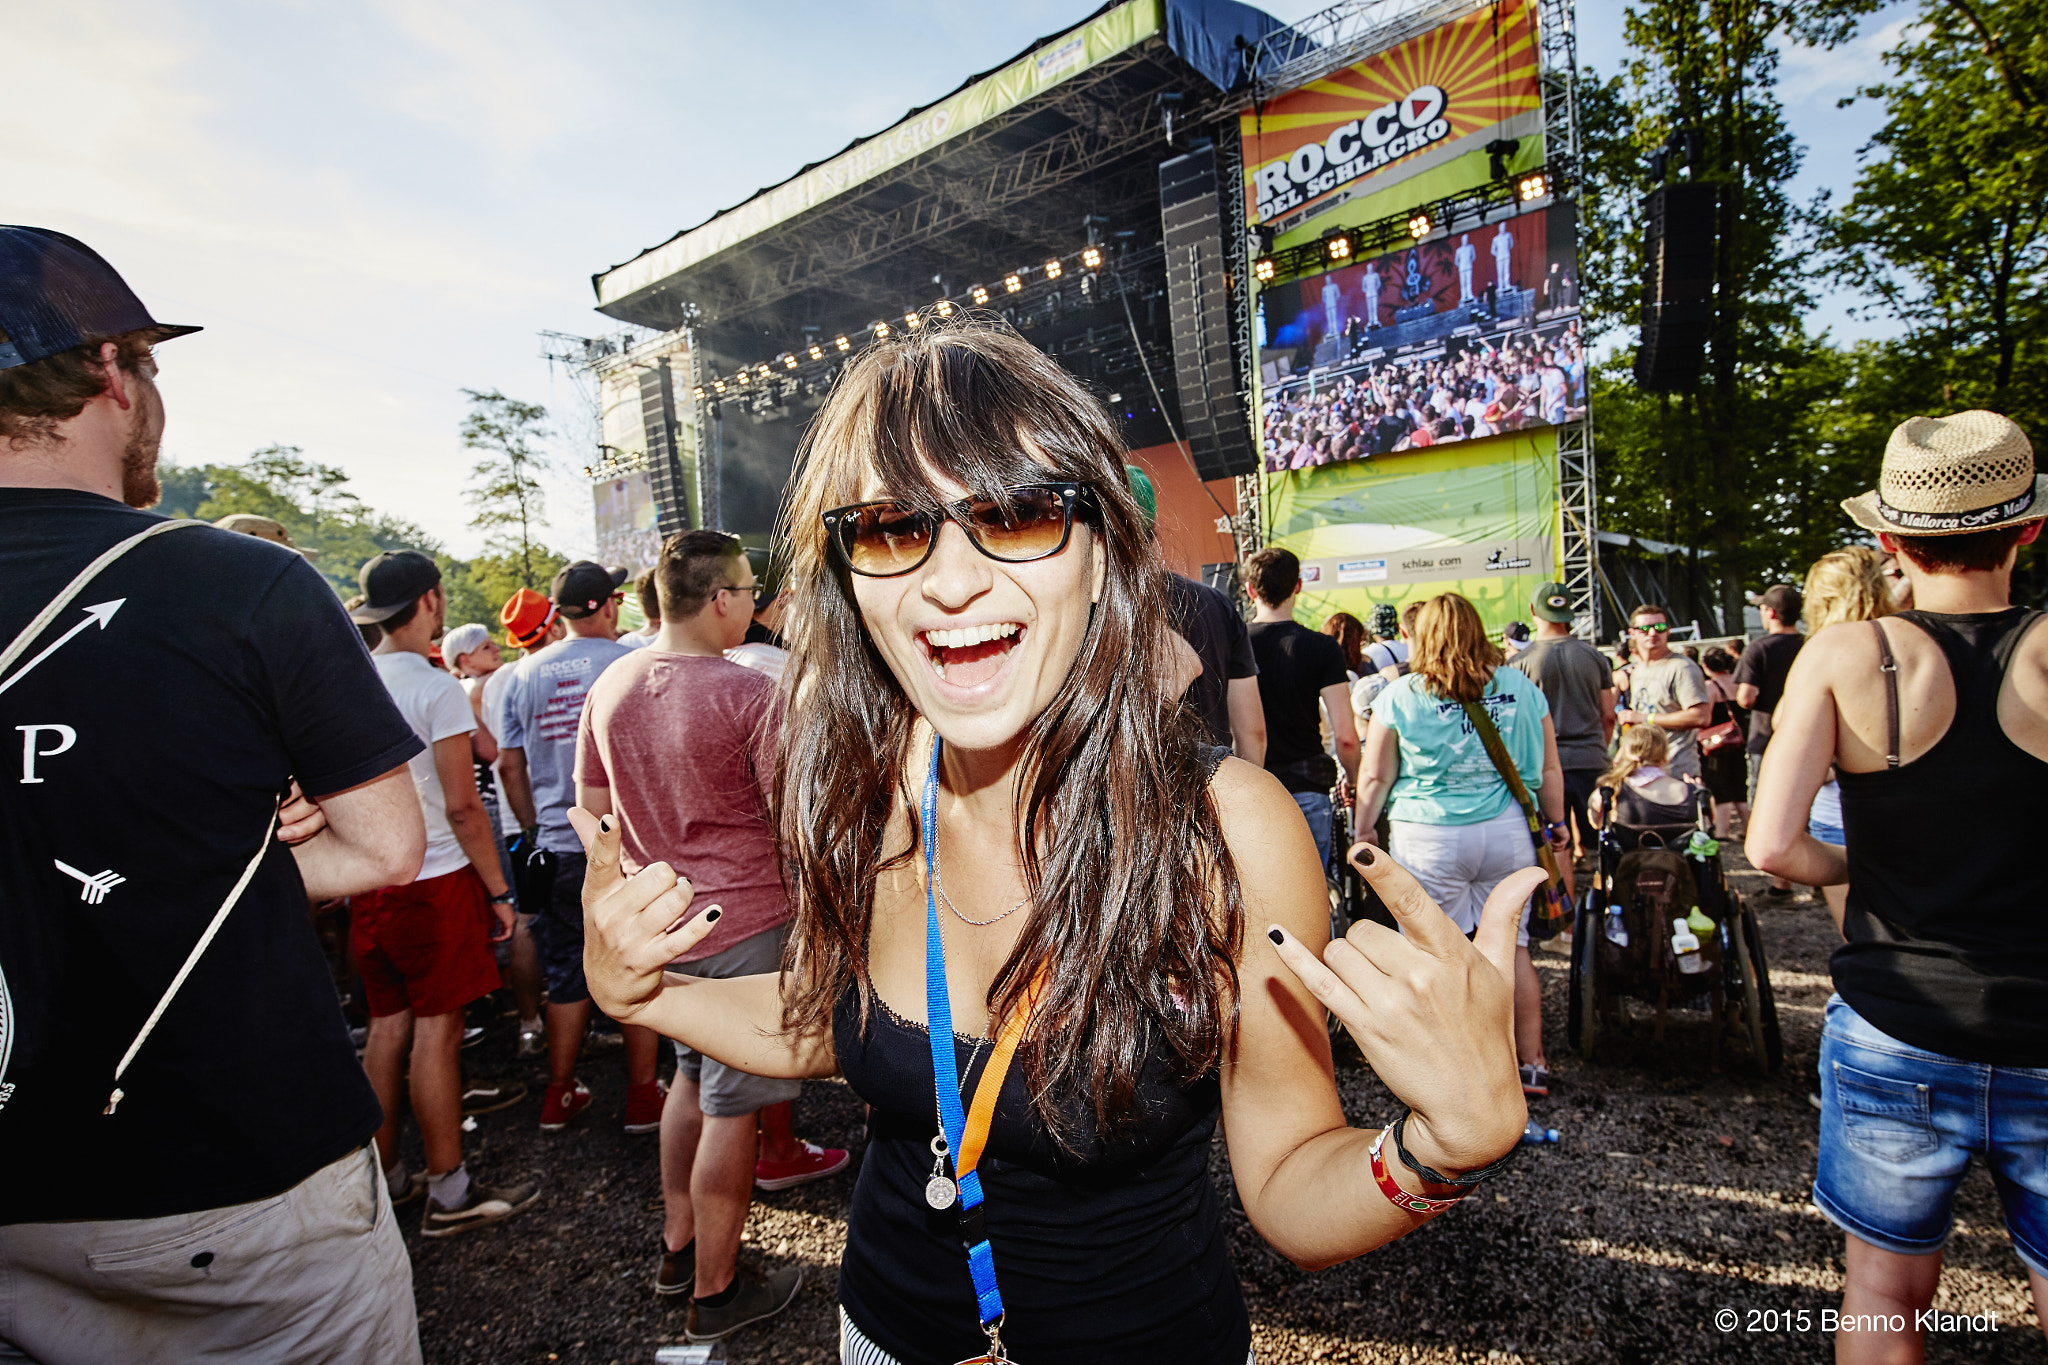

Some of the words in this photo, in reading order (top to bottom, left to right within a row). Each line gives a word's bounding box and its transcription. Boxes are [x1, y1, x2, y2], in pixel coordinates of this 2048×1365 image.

[821, 108, 950, 192] SCHLACKO
[1253, 85, 1447, 206] ROCCO
[1257, 188, 1303, 223] DEL
[1307, 118, 1449, 198] SCHLACKO
[1900, 513, 1960, 529] Mallorca
[541, 657, 591, 674] ROCCO
[15, 724, 77, 784] P
